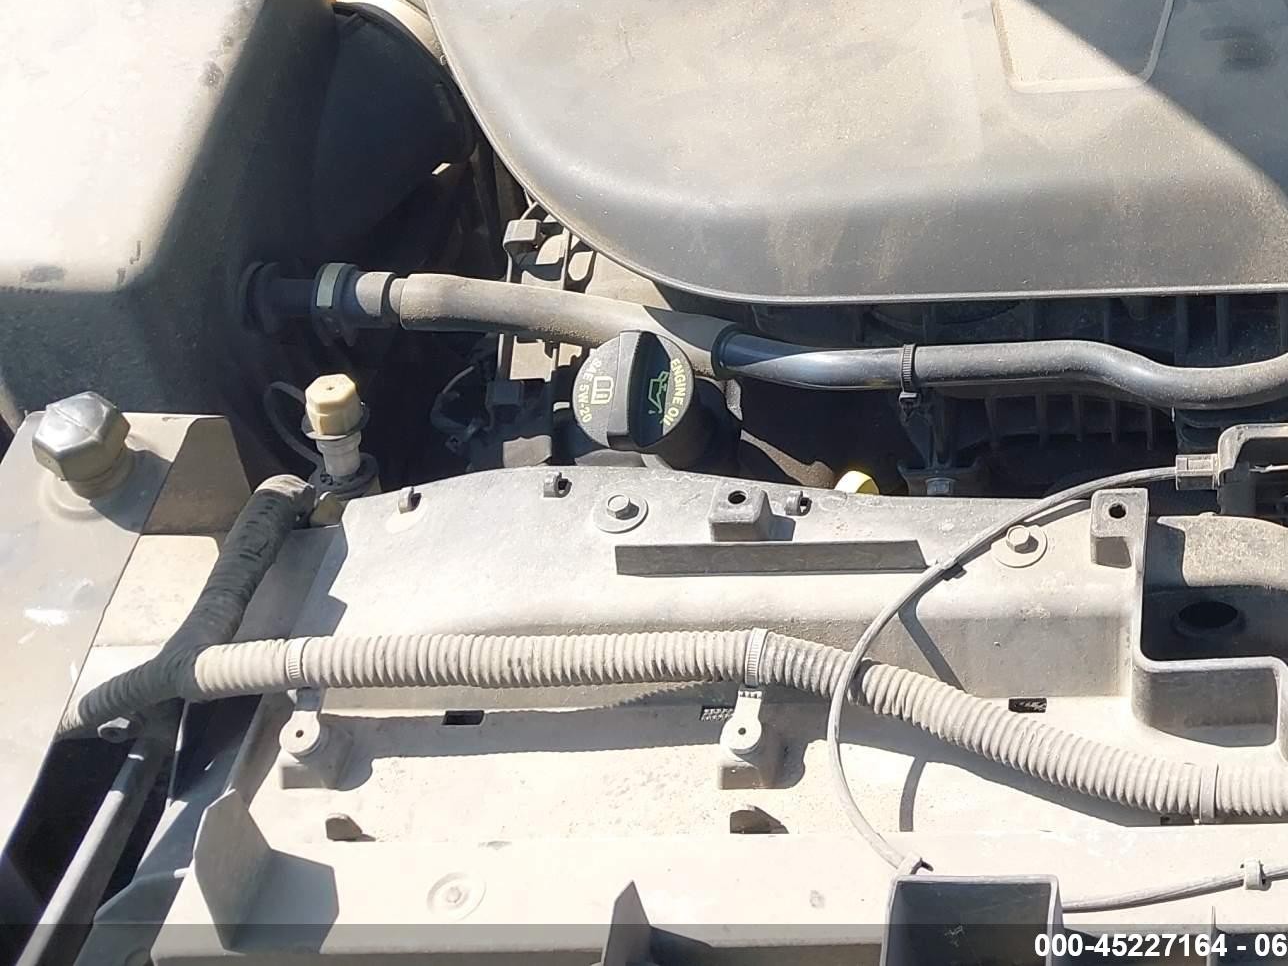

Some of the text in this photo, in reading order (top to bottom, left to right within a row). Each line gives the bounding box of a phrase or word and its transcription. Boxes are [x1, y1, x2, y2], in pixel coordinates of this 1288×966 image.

[578, 357, 602, 423] SAE 5W-20
[662, 358, 687, 427] ENGINE OIL
